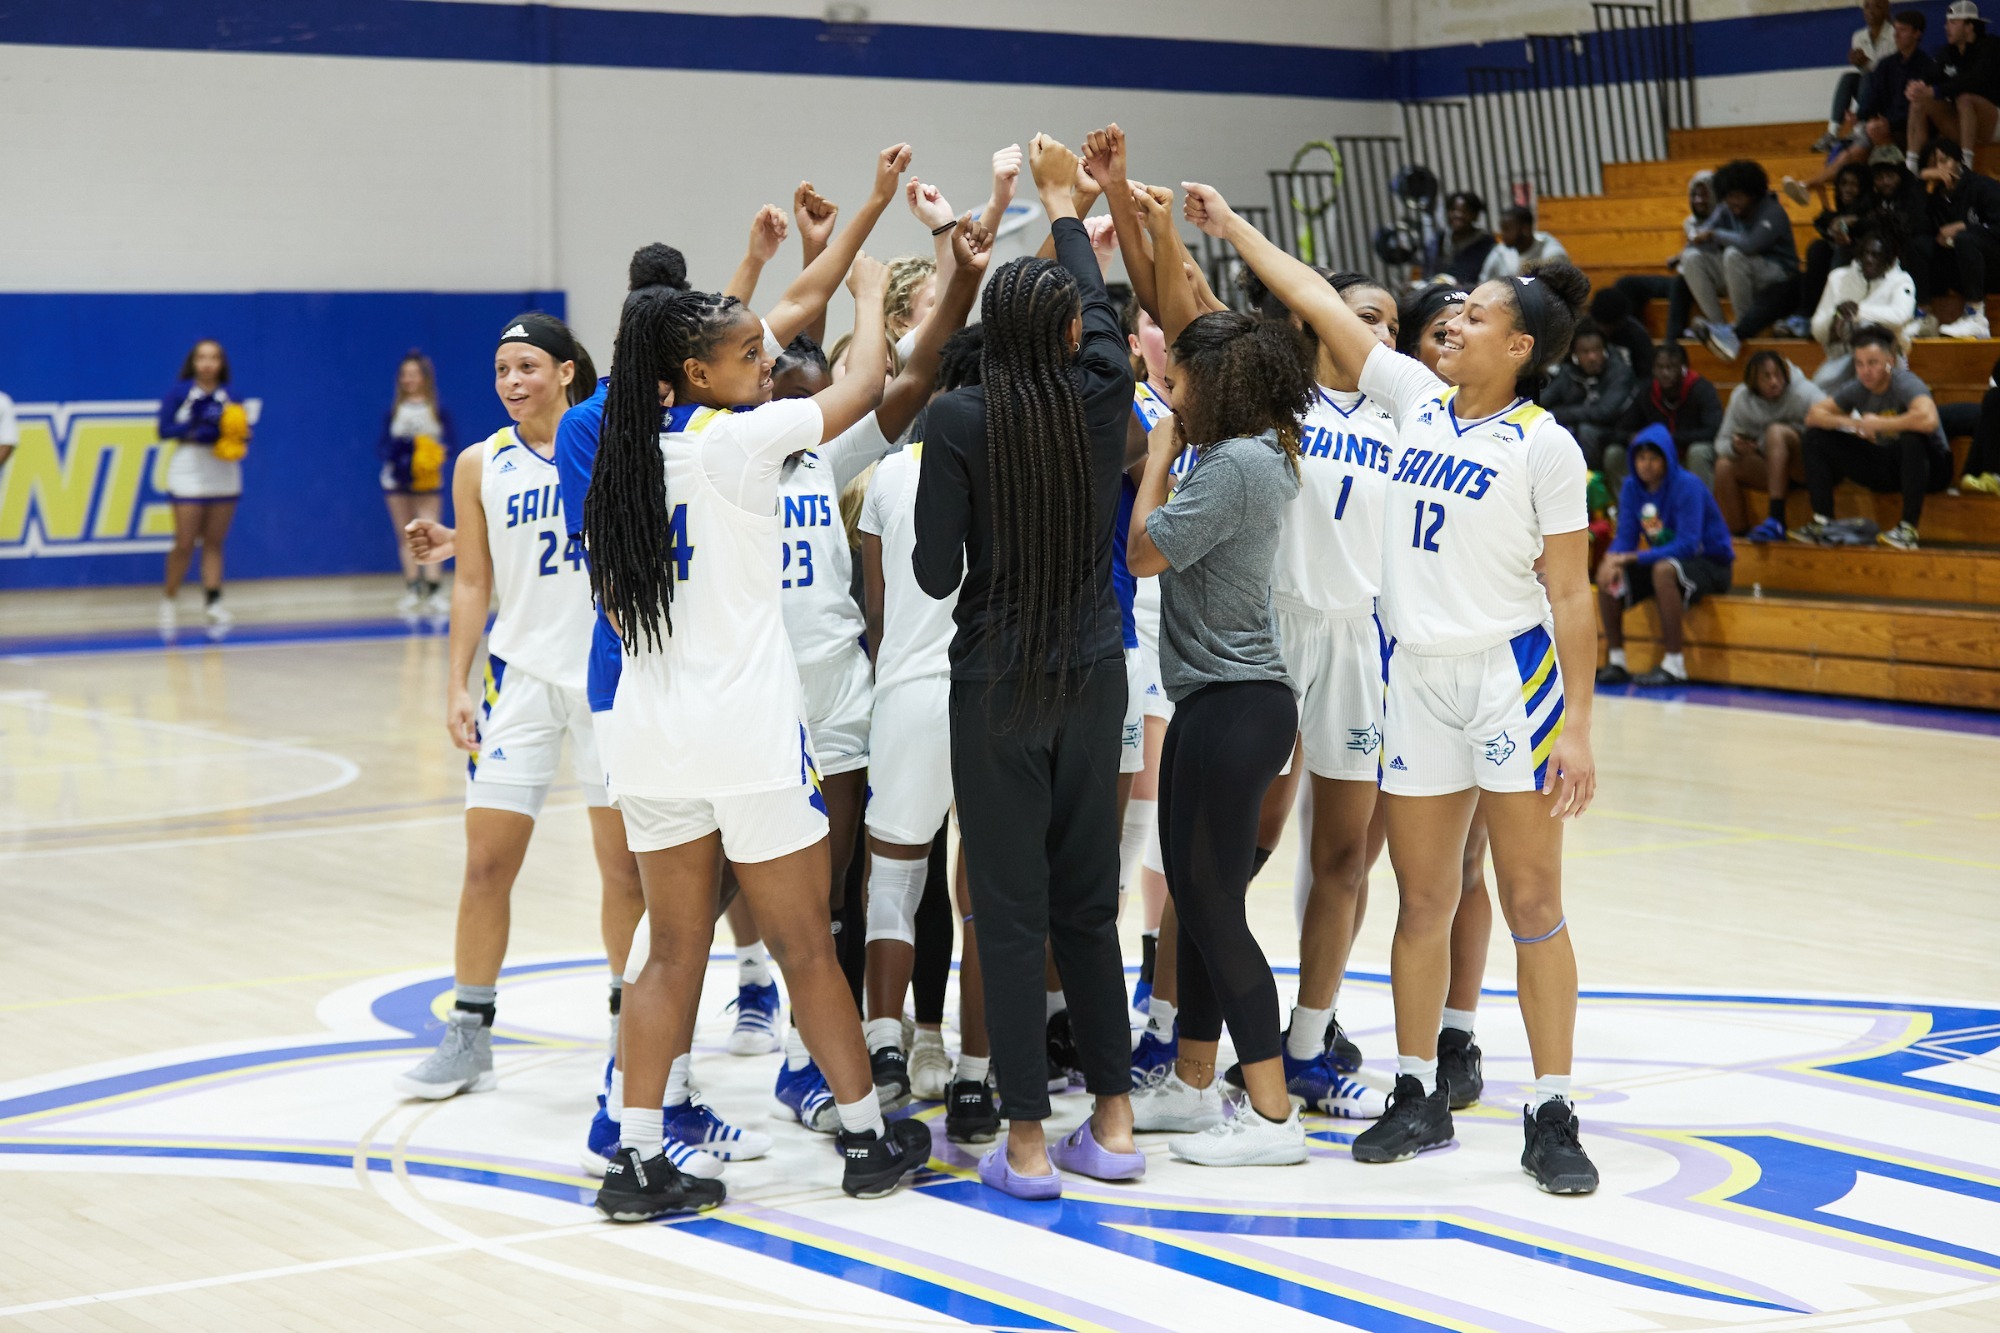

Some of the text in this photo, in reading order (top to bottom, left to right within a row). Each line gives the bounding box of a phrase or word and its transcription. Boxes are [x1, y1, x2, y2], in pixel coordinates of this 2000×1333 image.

[1300, 424, 1393, 475] SAINTS
[1391, 447, 1499, 501] SAINTS
[1334, 475, 1354, 521] 1
[1412, 499, 1446, 553] 12
[538, 530, 584, 577] 24
